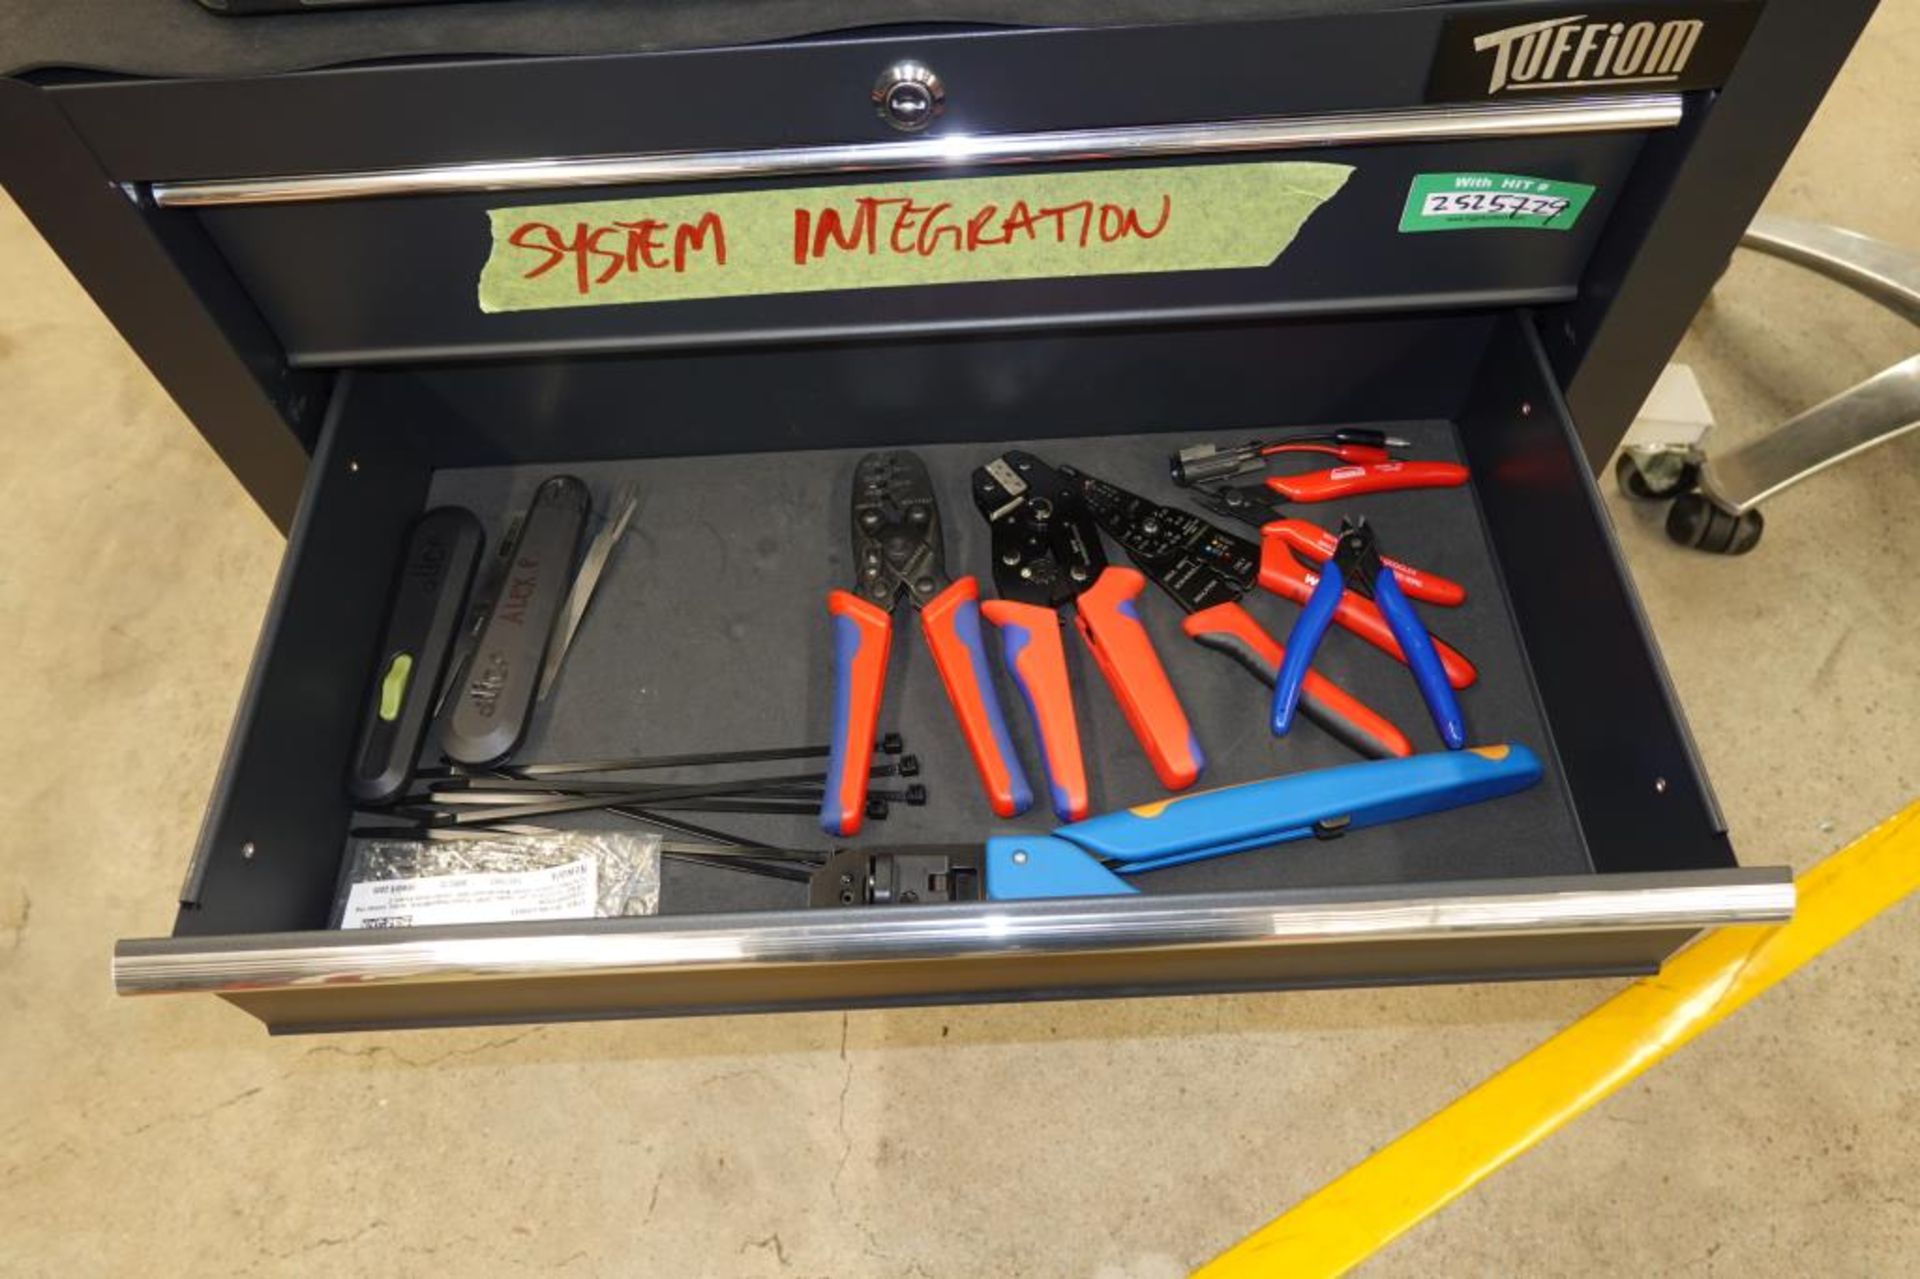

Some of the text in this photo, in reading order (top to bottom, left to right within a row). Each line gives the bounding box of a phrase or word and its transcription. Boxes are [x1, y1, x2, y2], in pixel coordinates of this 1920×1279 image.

[1455, 176, 1492, 189] With
[1501, 177, 1533, 191] HIT
[508, 195, 1170, 294] SYSTEM INTEGRATION
